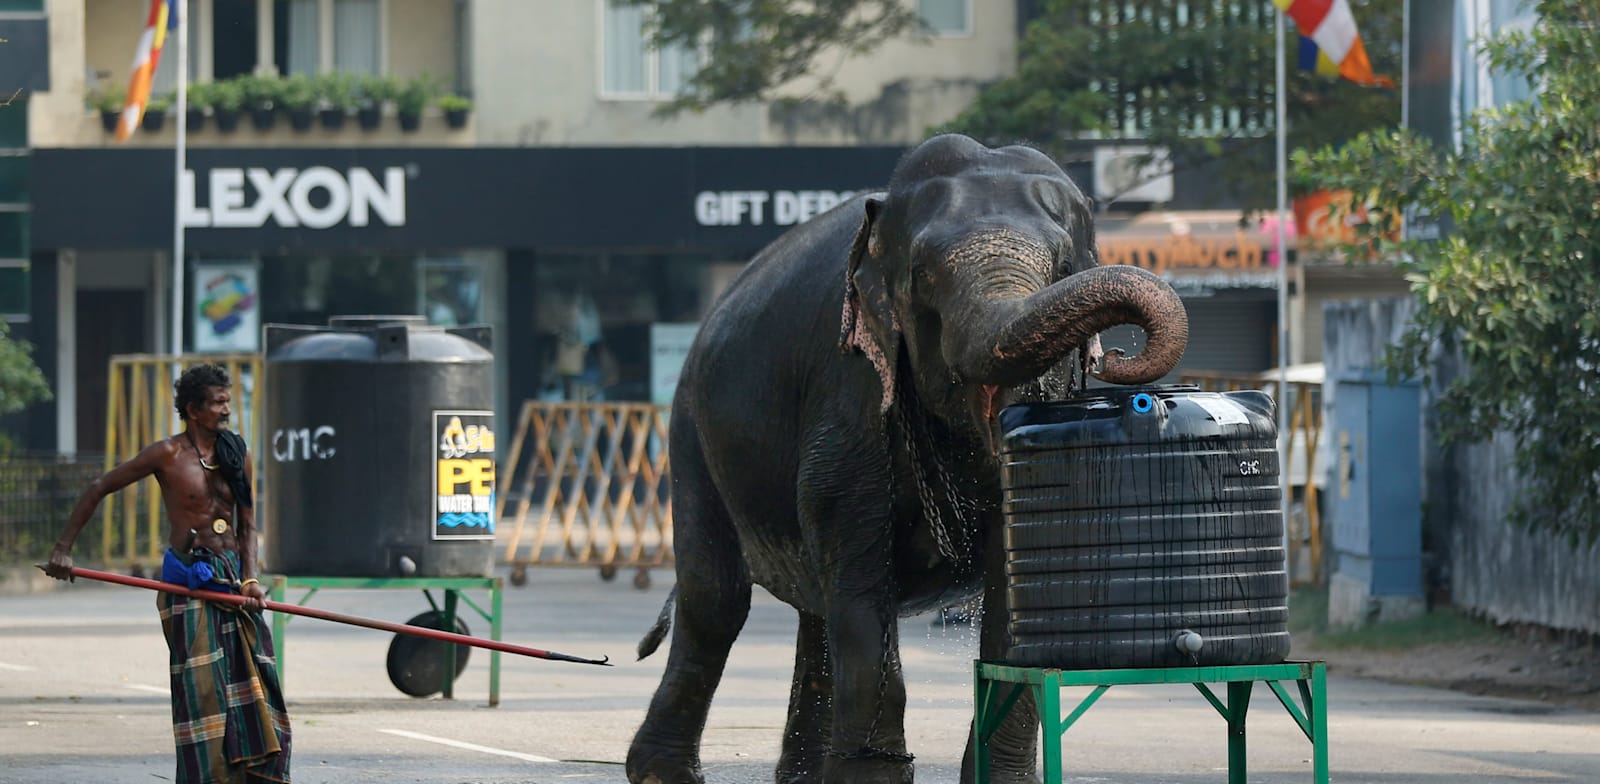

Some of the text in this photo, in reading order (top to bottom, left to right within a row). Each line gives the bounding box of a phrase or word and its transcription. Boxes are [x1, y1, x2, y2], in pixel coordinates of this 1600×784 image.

[184, 165, 406, 229] LEXON
[696, 190, 854, 226] GIFT DEP
[272, 425, 336, 461] CMC
[438, 494, 473, 513] WATER
